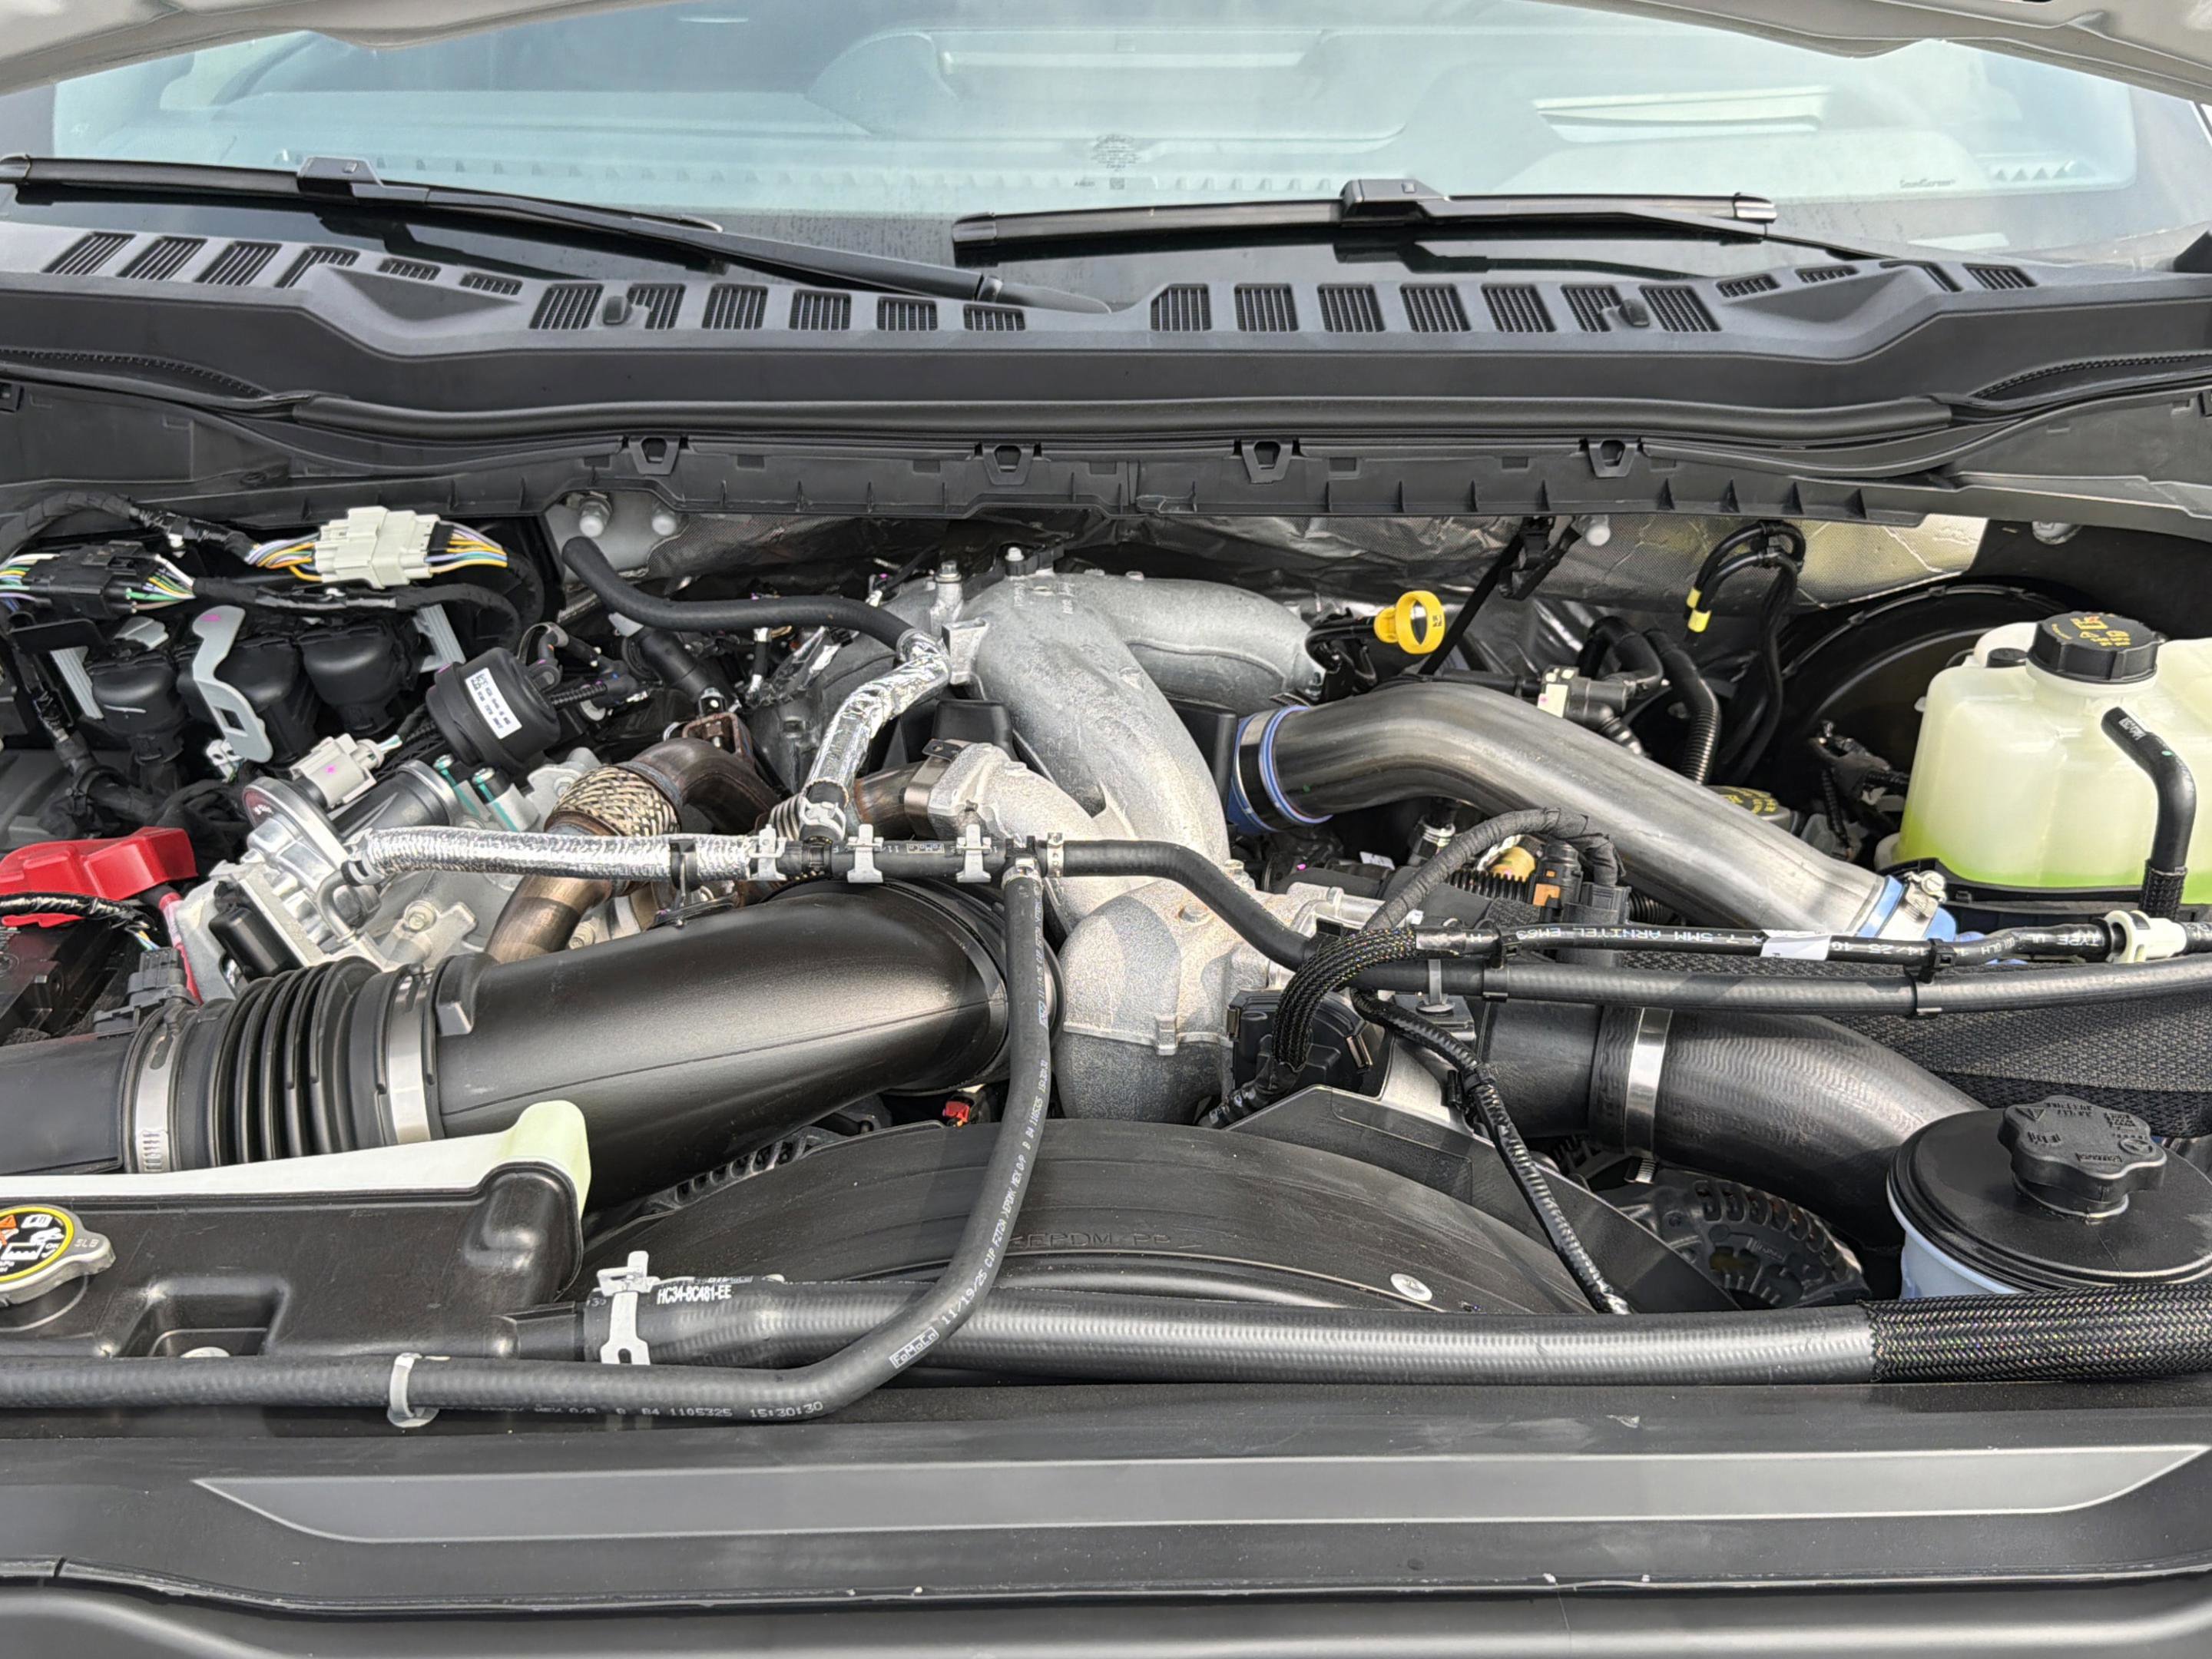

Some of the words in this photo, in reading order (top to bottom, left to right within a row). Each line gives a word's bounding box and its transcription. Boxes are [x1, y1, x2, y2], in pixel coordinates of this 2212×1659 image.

[908, 843, 944, 853] FoMoCo
[1573, 926, 1661, 939] ARNITEL
[1674, 932, 1740, 944] 7.5MM
[657, 1284, 732, 1305] HC34-8C481-EE
[890, 1328, 939, 1368] FoMoCo
[942, 1269, 988, 1325] 11/19/25
[670, 1407, 733, 1417] 1105325
[750, 1400, 823, 1419] 15:30:30
